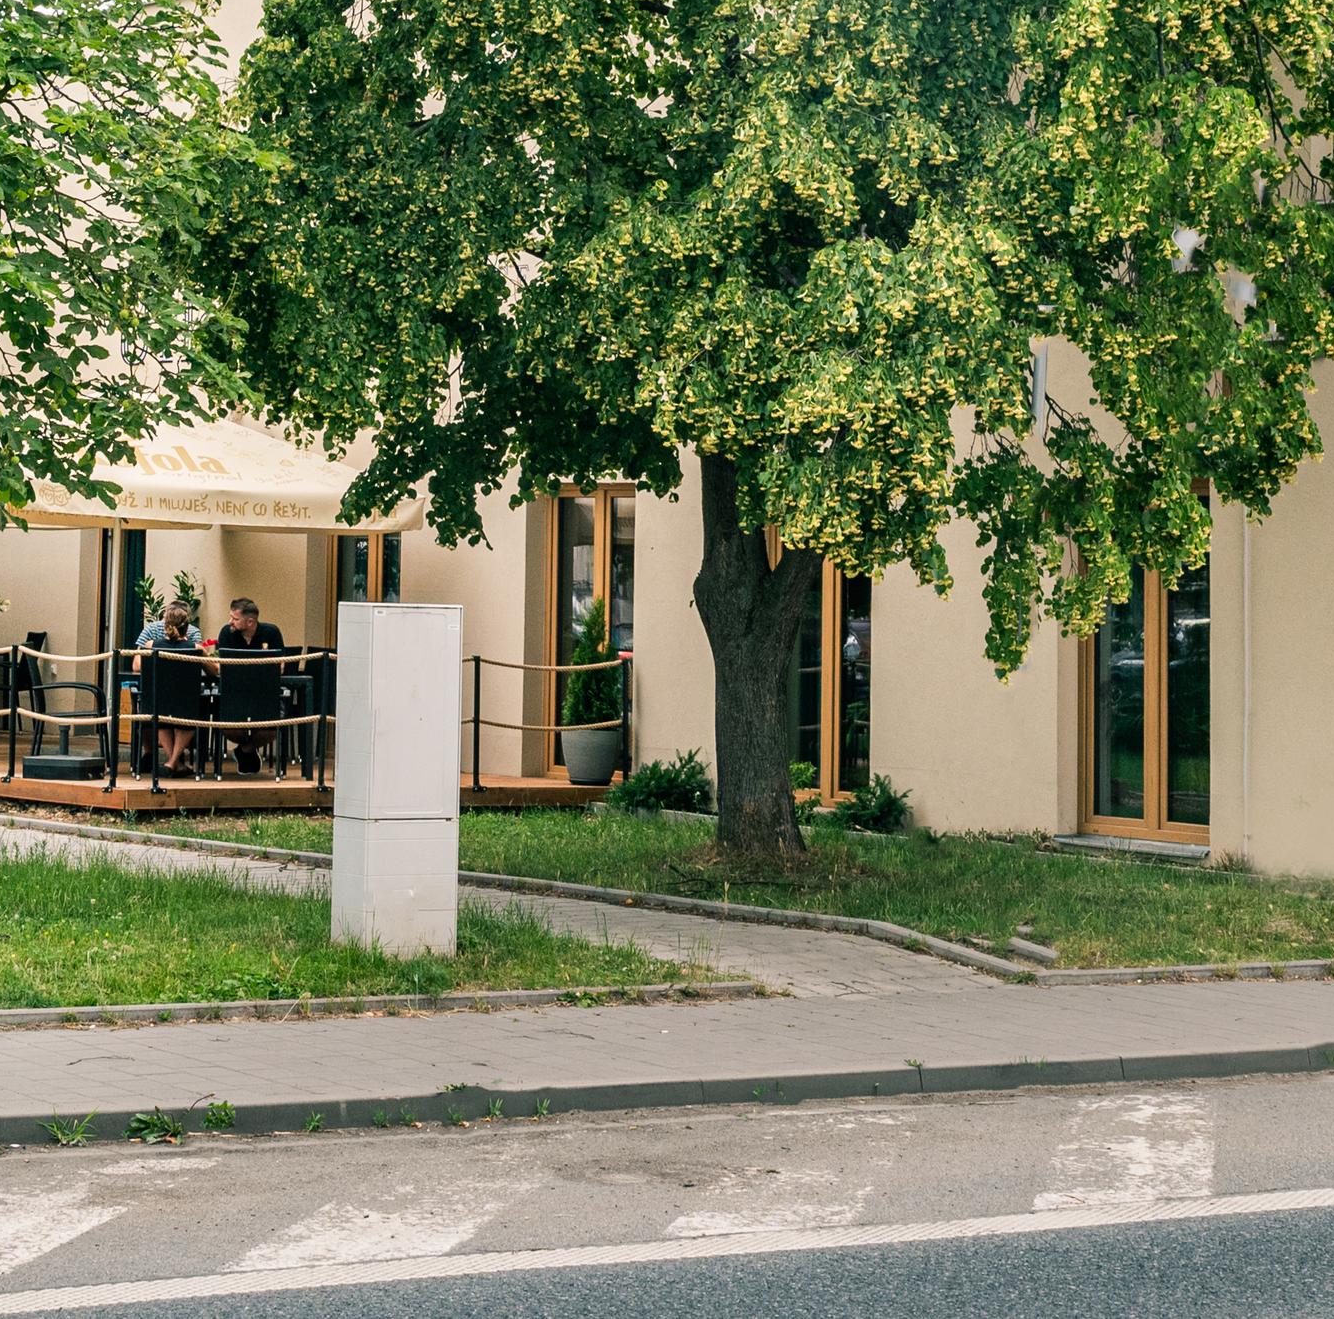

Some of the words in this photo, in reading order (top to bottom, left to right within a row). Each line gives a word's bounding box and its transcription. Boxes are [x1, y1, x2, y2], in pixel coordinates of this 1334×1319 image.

[144, 497, 153, 510] JI
[159, 493, 211, 514] MILUJEŠ,
[216, 500, 249, 517] NENÍ
[252, 502, 267, 516] CO
[273, 500, 311, 519] ŘEŠIT.
